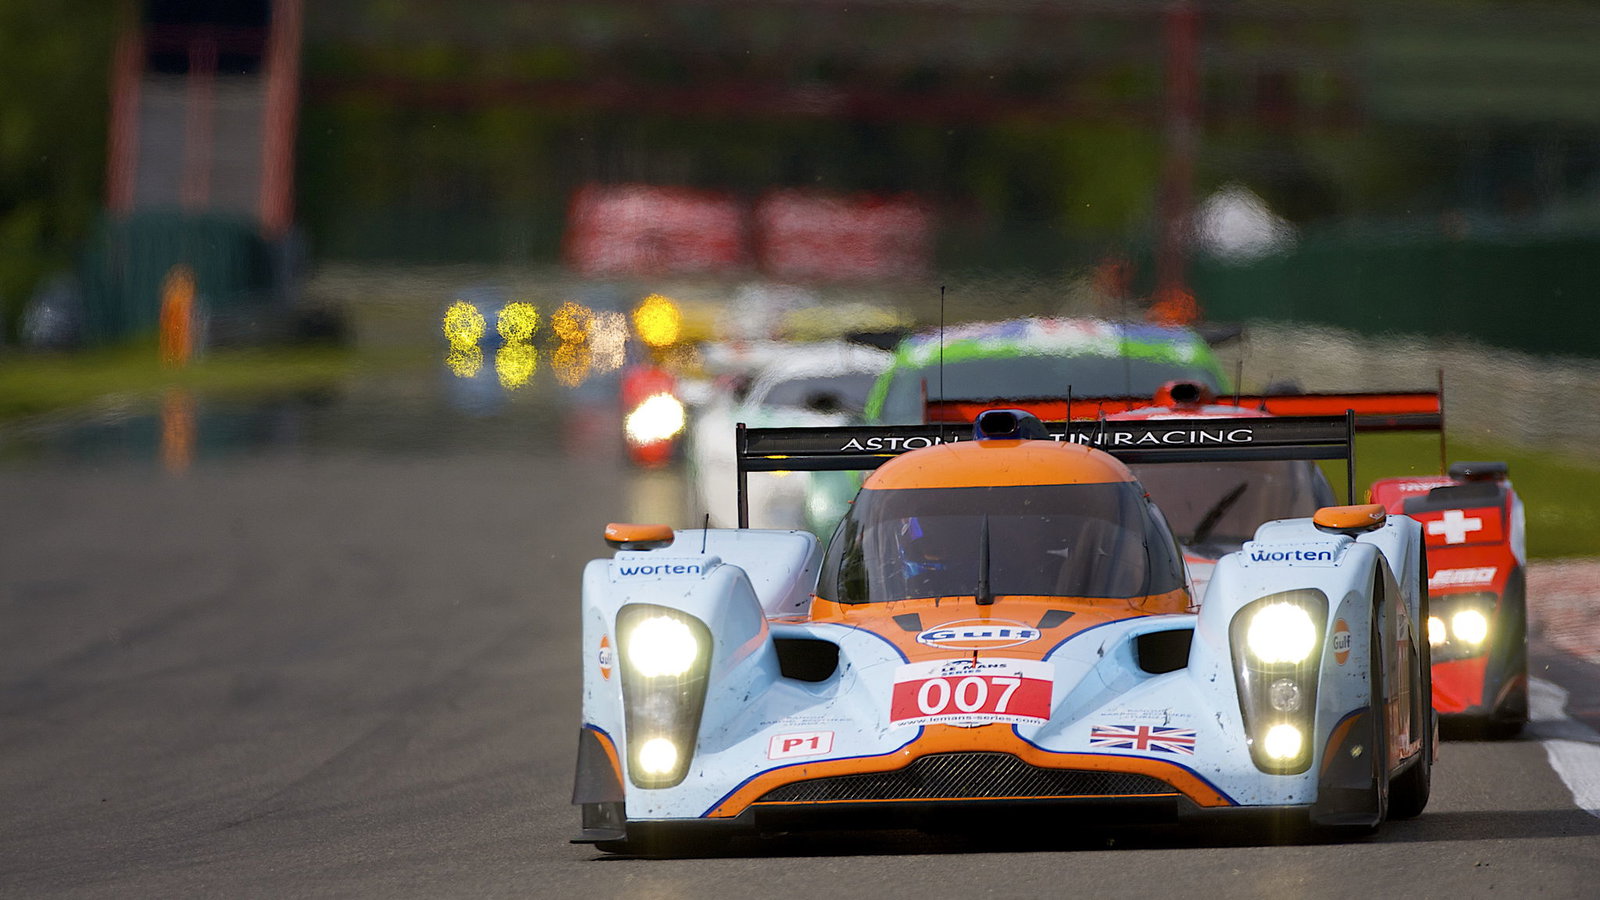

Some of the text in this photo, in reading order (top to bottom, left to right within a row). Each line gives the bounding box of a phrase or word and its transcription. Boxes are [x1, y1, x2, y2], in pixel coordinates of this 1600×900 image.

[1049, 432, 1101, 444] TIN
[1114, 429, 1253, 445] RACING
[1251, 550, 1332, 562] worten
[620, 564, 700, 576] worten
[920, 629, 1035, 641] Gulf
[1333, 634, 1350, 650] Gulf
[917, 675, 1022, 715] 007
[897, 714, 1042, 727] www.lemans-series.com
[782, 735, 820, 753] P1
